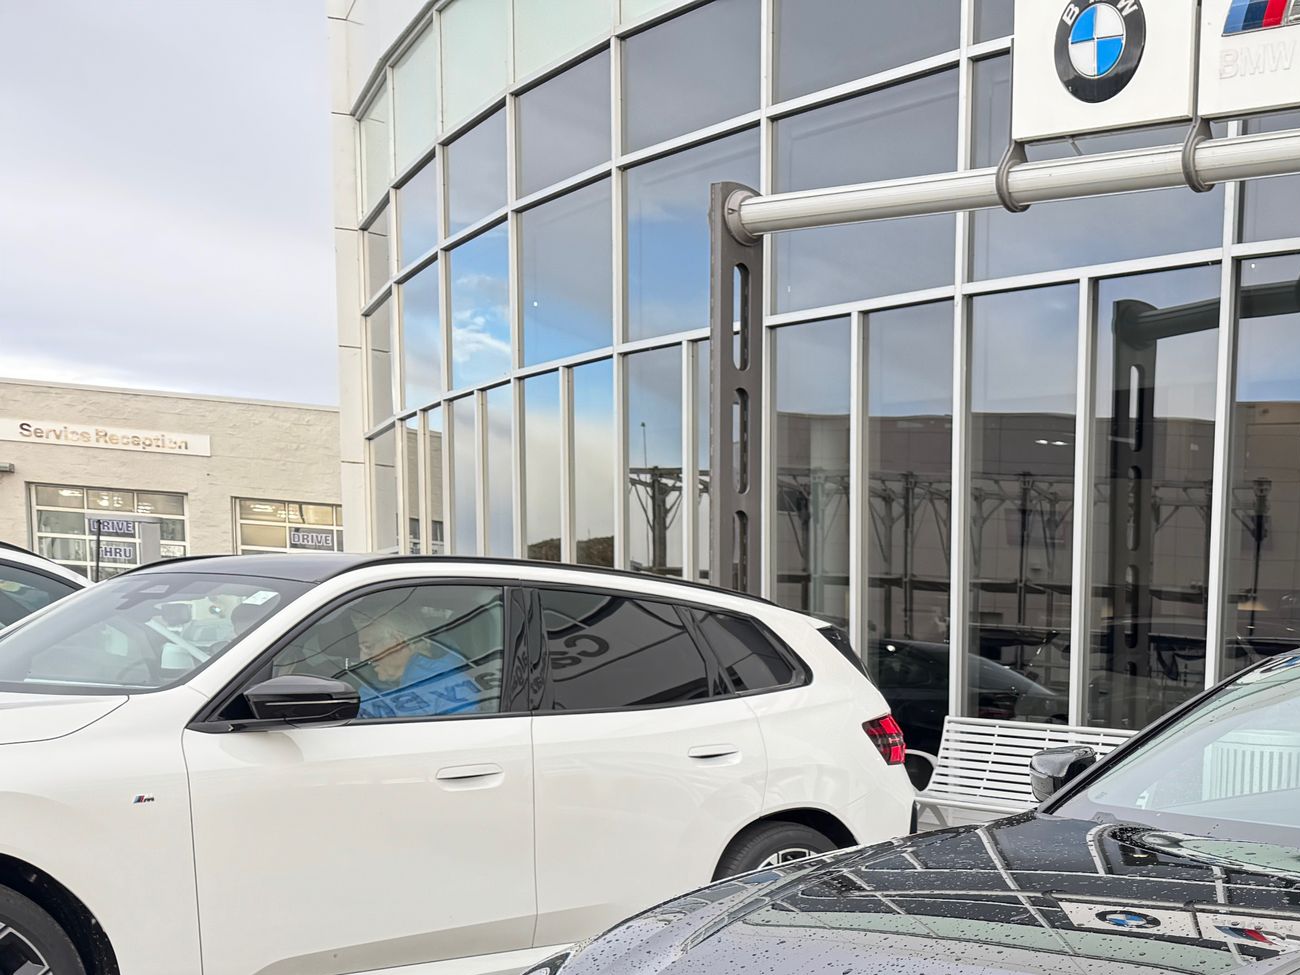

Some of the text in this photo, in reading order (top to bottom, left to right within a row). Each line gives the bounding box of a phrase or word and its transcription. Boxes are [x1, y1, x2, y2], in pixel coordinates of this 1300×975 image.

[1219, 40, 1298, 79] BMW
[19, 422, 188, 449] Service Reception
[291, 532, 332, 545] DRIVE
